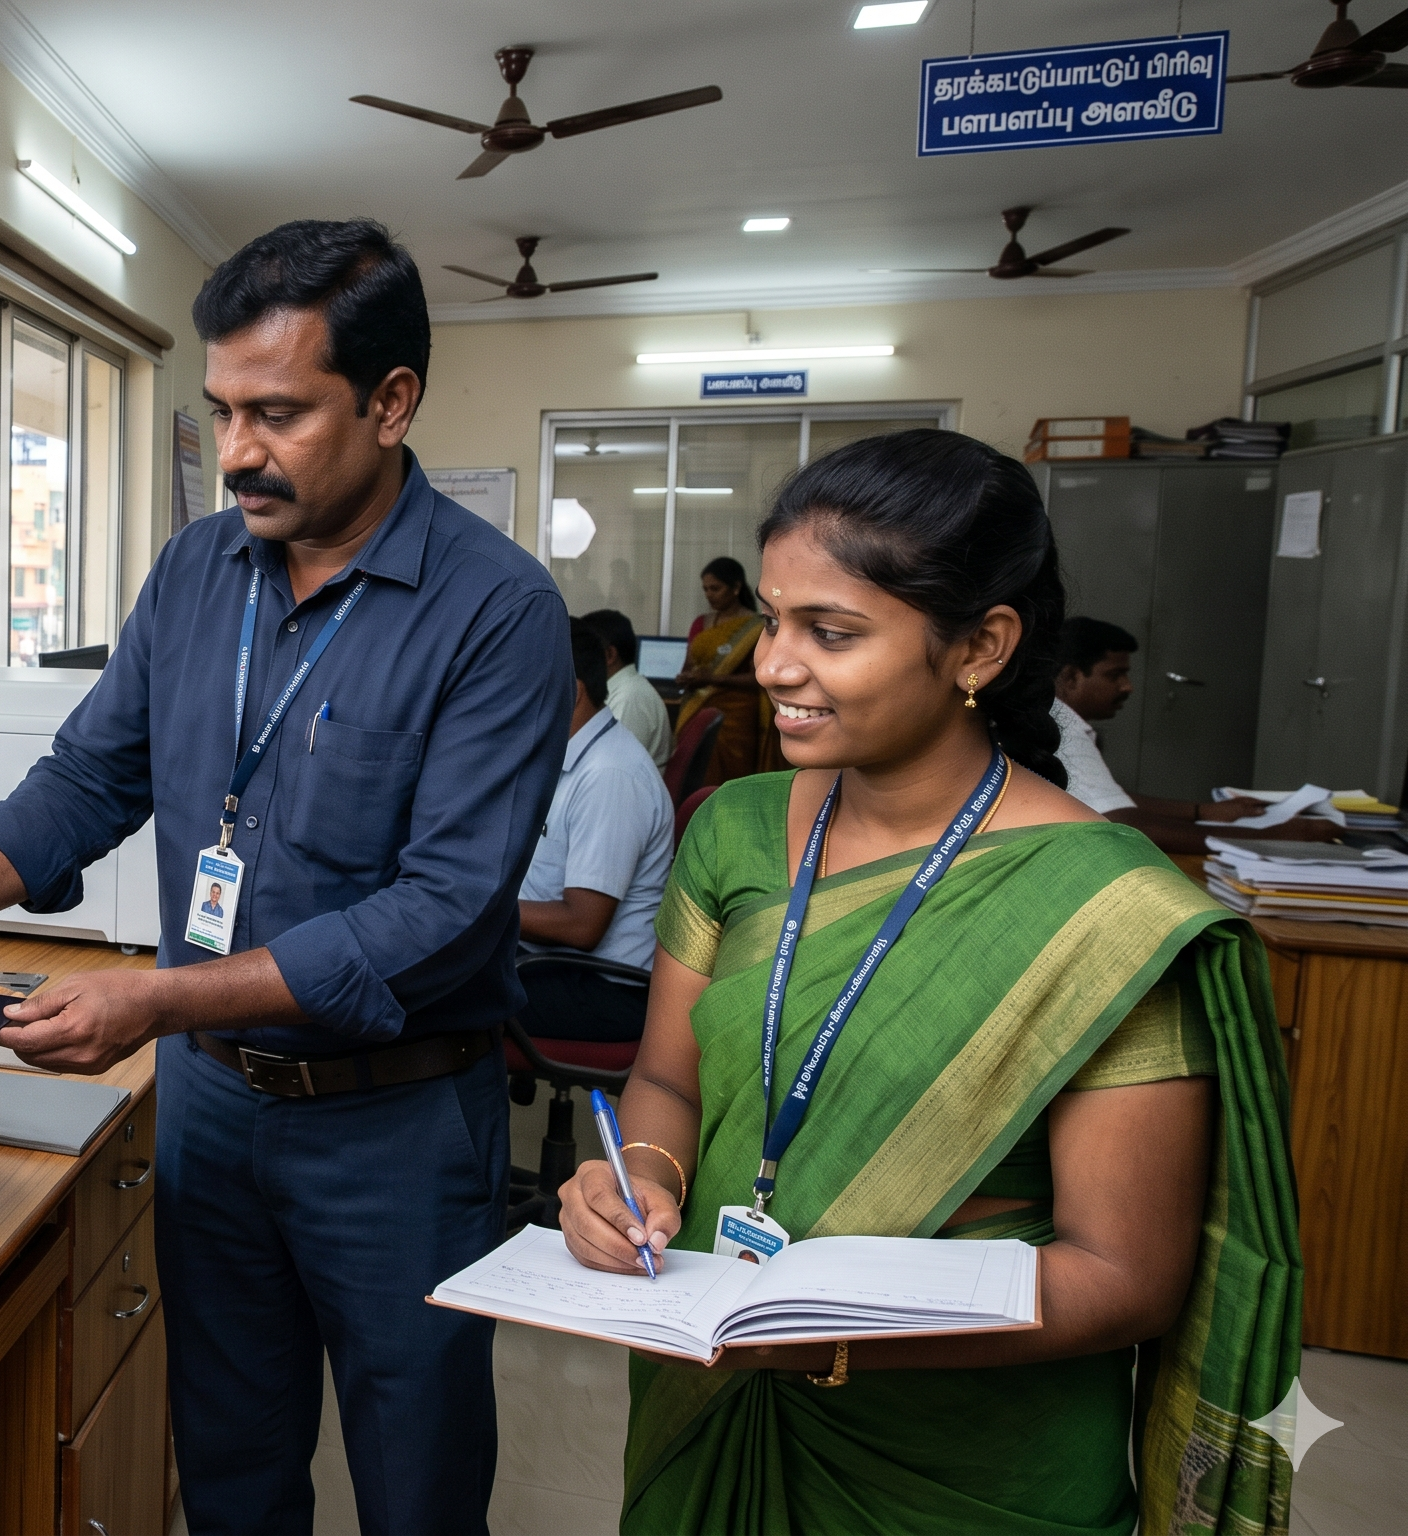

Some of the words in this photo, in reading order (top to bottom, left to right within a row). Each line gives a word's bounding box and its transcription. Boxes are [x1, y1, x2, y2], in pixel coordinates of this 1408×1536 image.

[933, 54, 1140, 105] தரக்கட்டுப்பாட்டுப்
[1145, 50, 1214, 79] பிரிவு
[942, 101, 1074, 136] பளபளப்பு
[1081, 88, 1199, 127] அளவீடு
